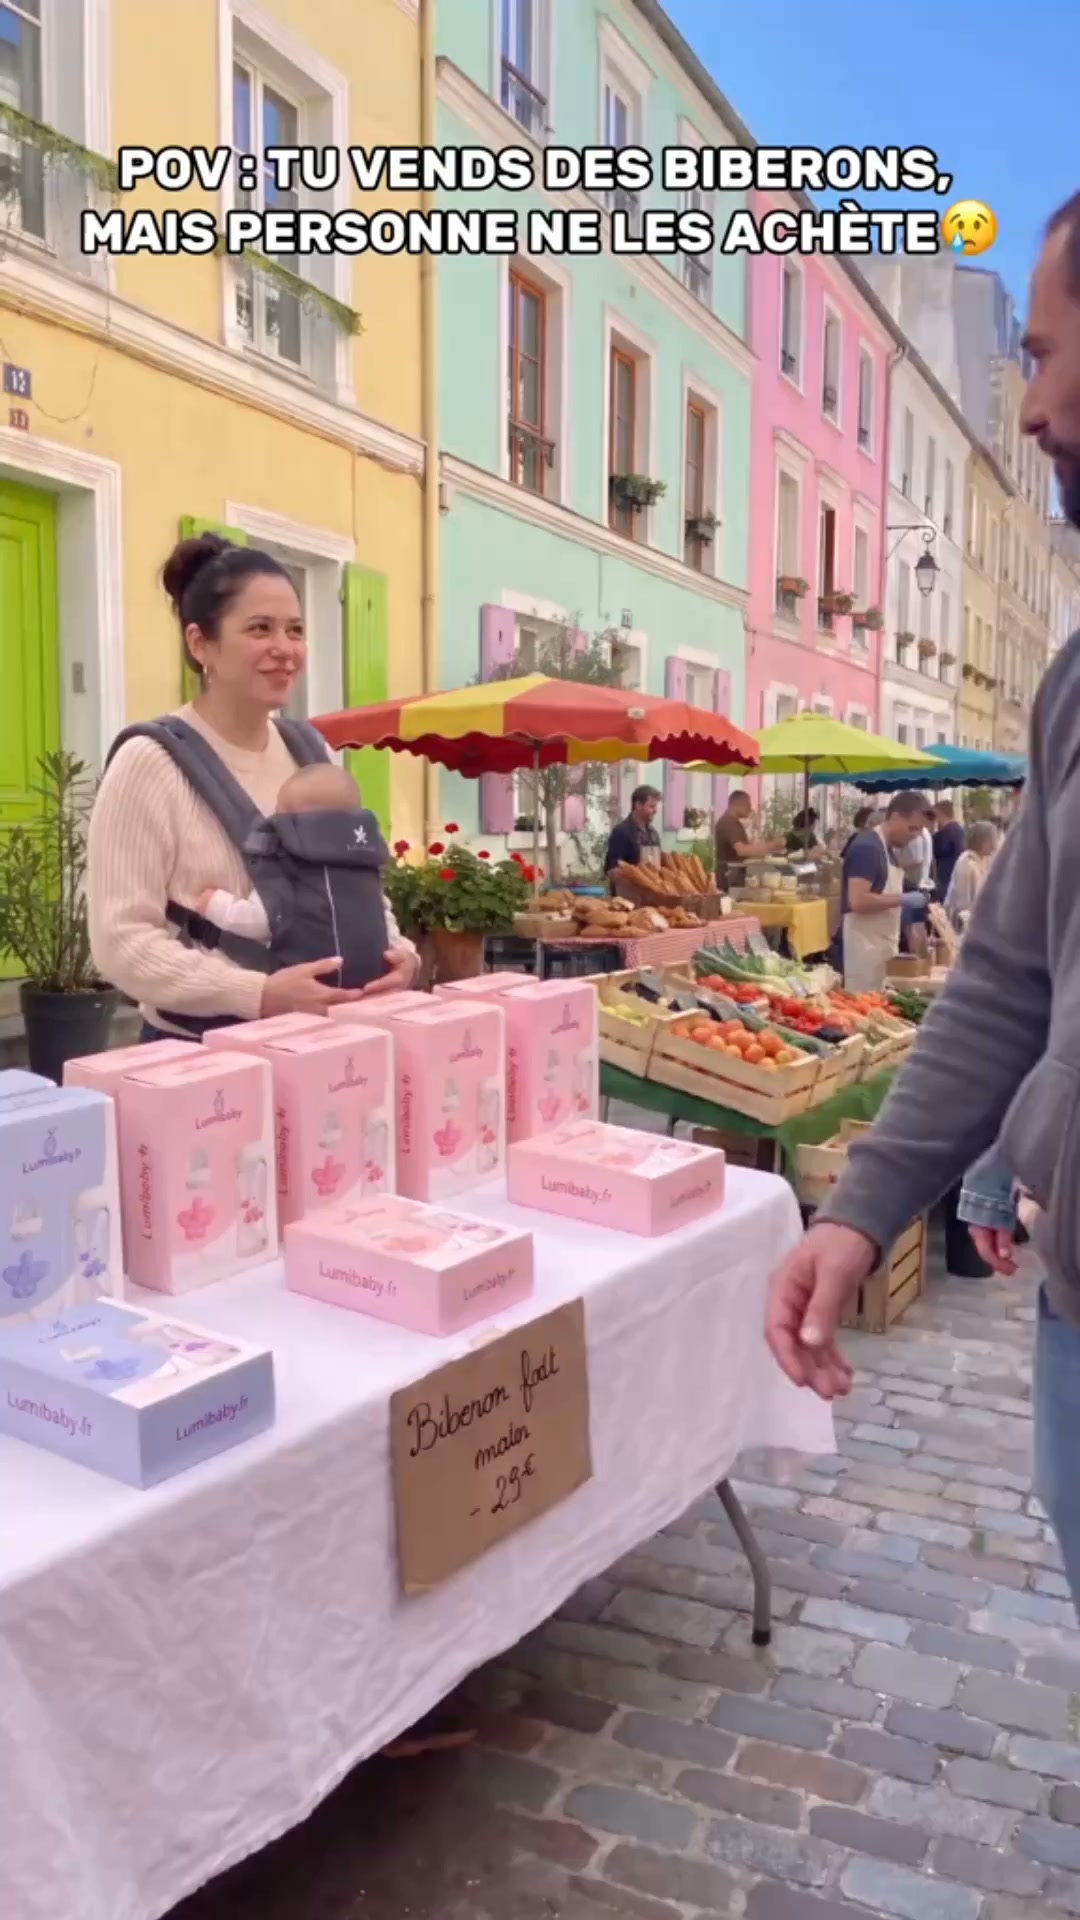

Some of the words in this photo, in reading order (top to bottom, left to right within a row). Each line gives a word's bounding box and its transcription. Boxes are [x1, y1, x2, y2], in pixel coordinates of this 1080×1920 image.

[541, 1175, 612, 1205] Lumibaby.fr
[318, 1260, 398, 1298] Lumibaby.fr
[7, 1391, 93, 1437] Lumibaby.fr
[175, 1395, 250, 1442] Lumibaby.fr
[406, 1385, 511, 1458] Biberon
